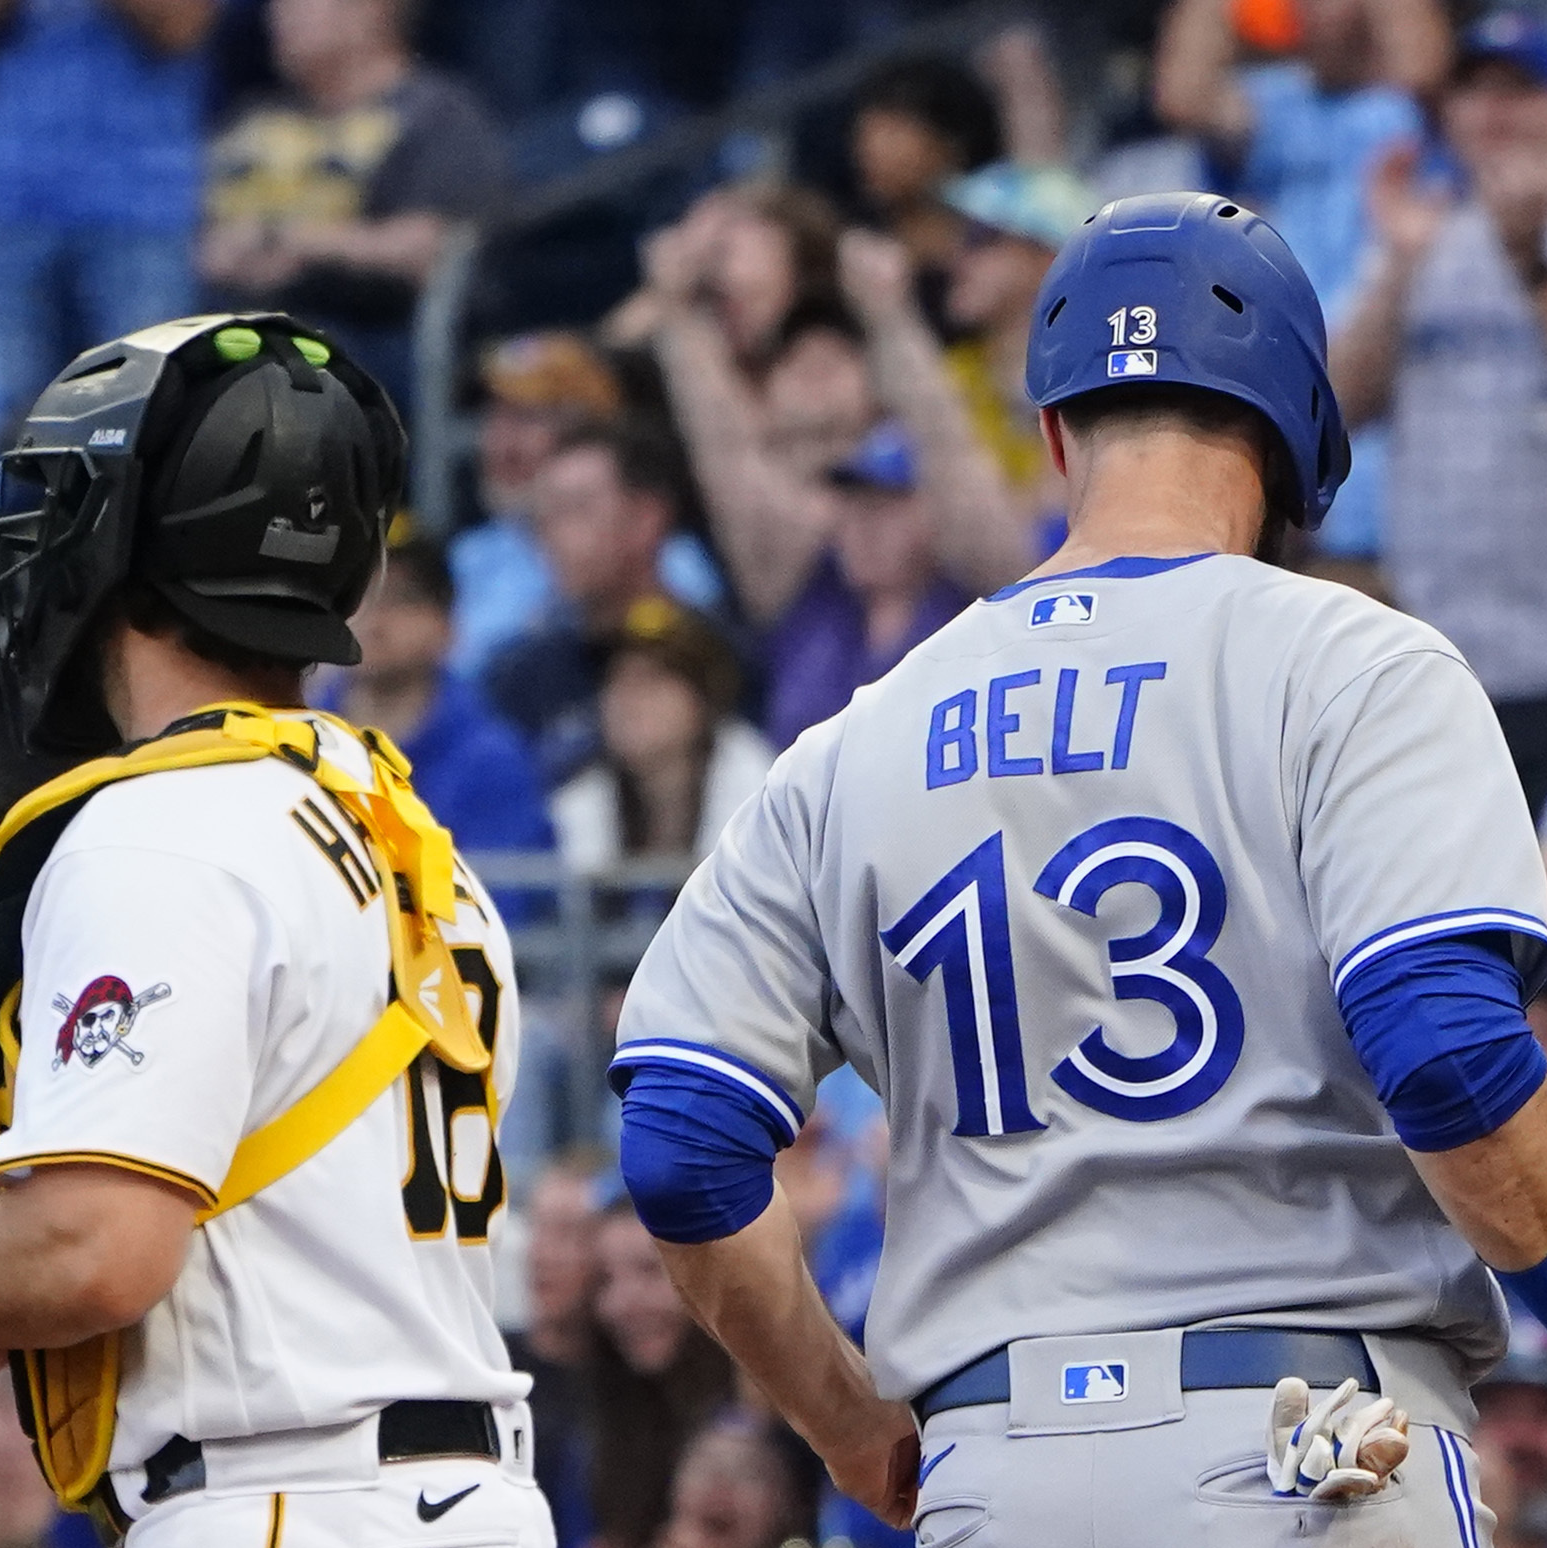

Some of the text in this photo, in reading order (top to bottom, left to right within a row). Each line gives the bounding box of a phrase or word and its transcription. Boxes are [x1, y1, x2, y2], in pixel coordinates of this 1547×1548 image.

[1107, 305, 1158, 346] 13
[926, 661, 1168, 791] BELT
[879, 815, 1246, 1137] 13
